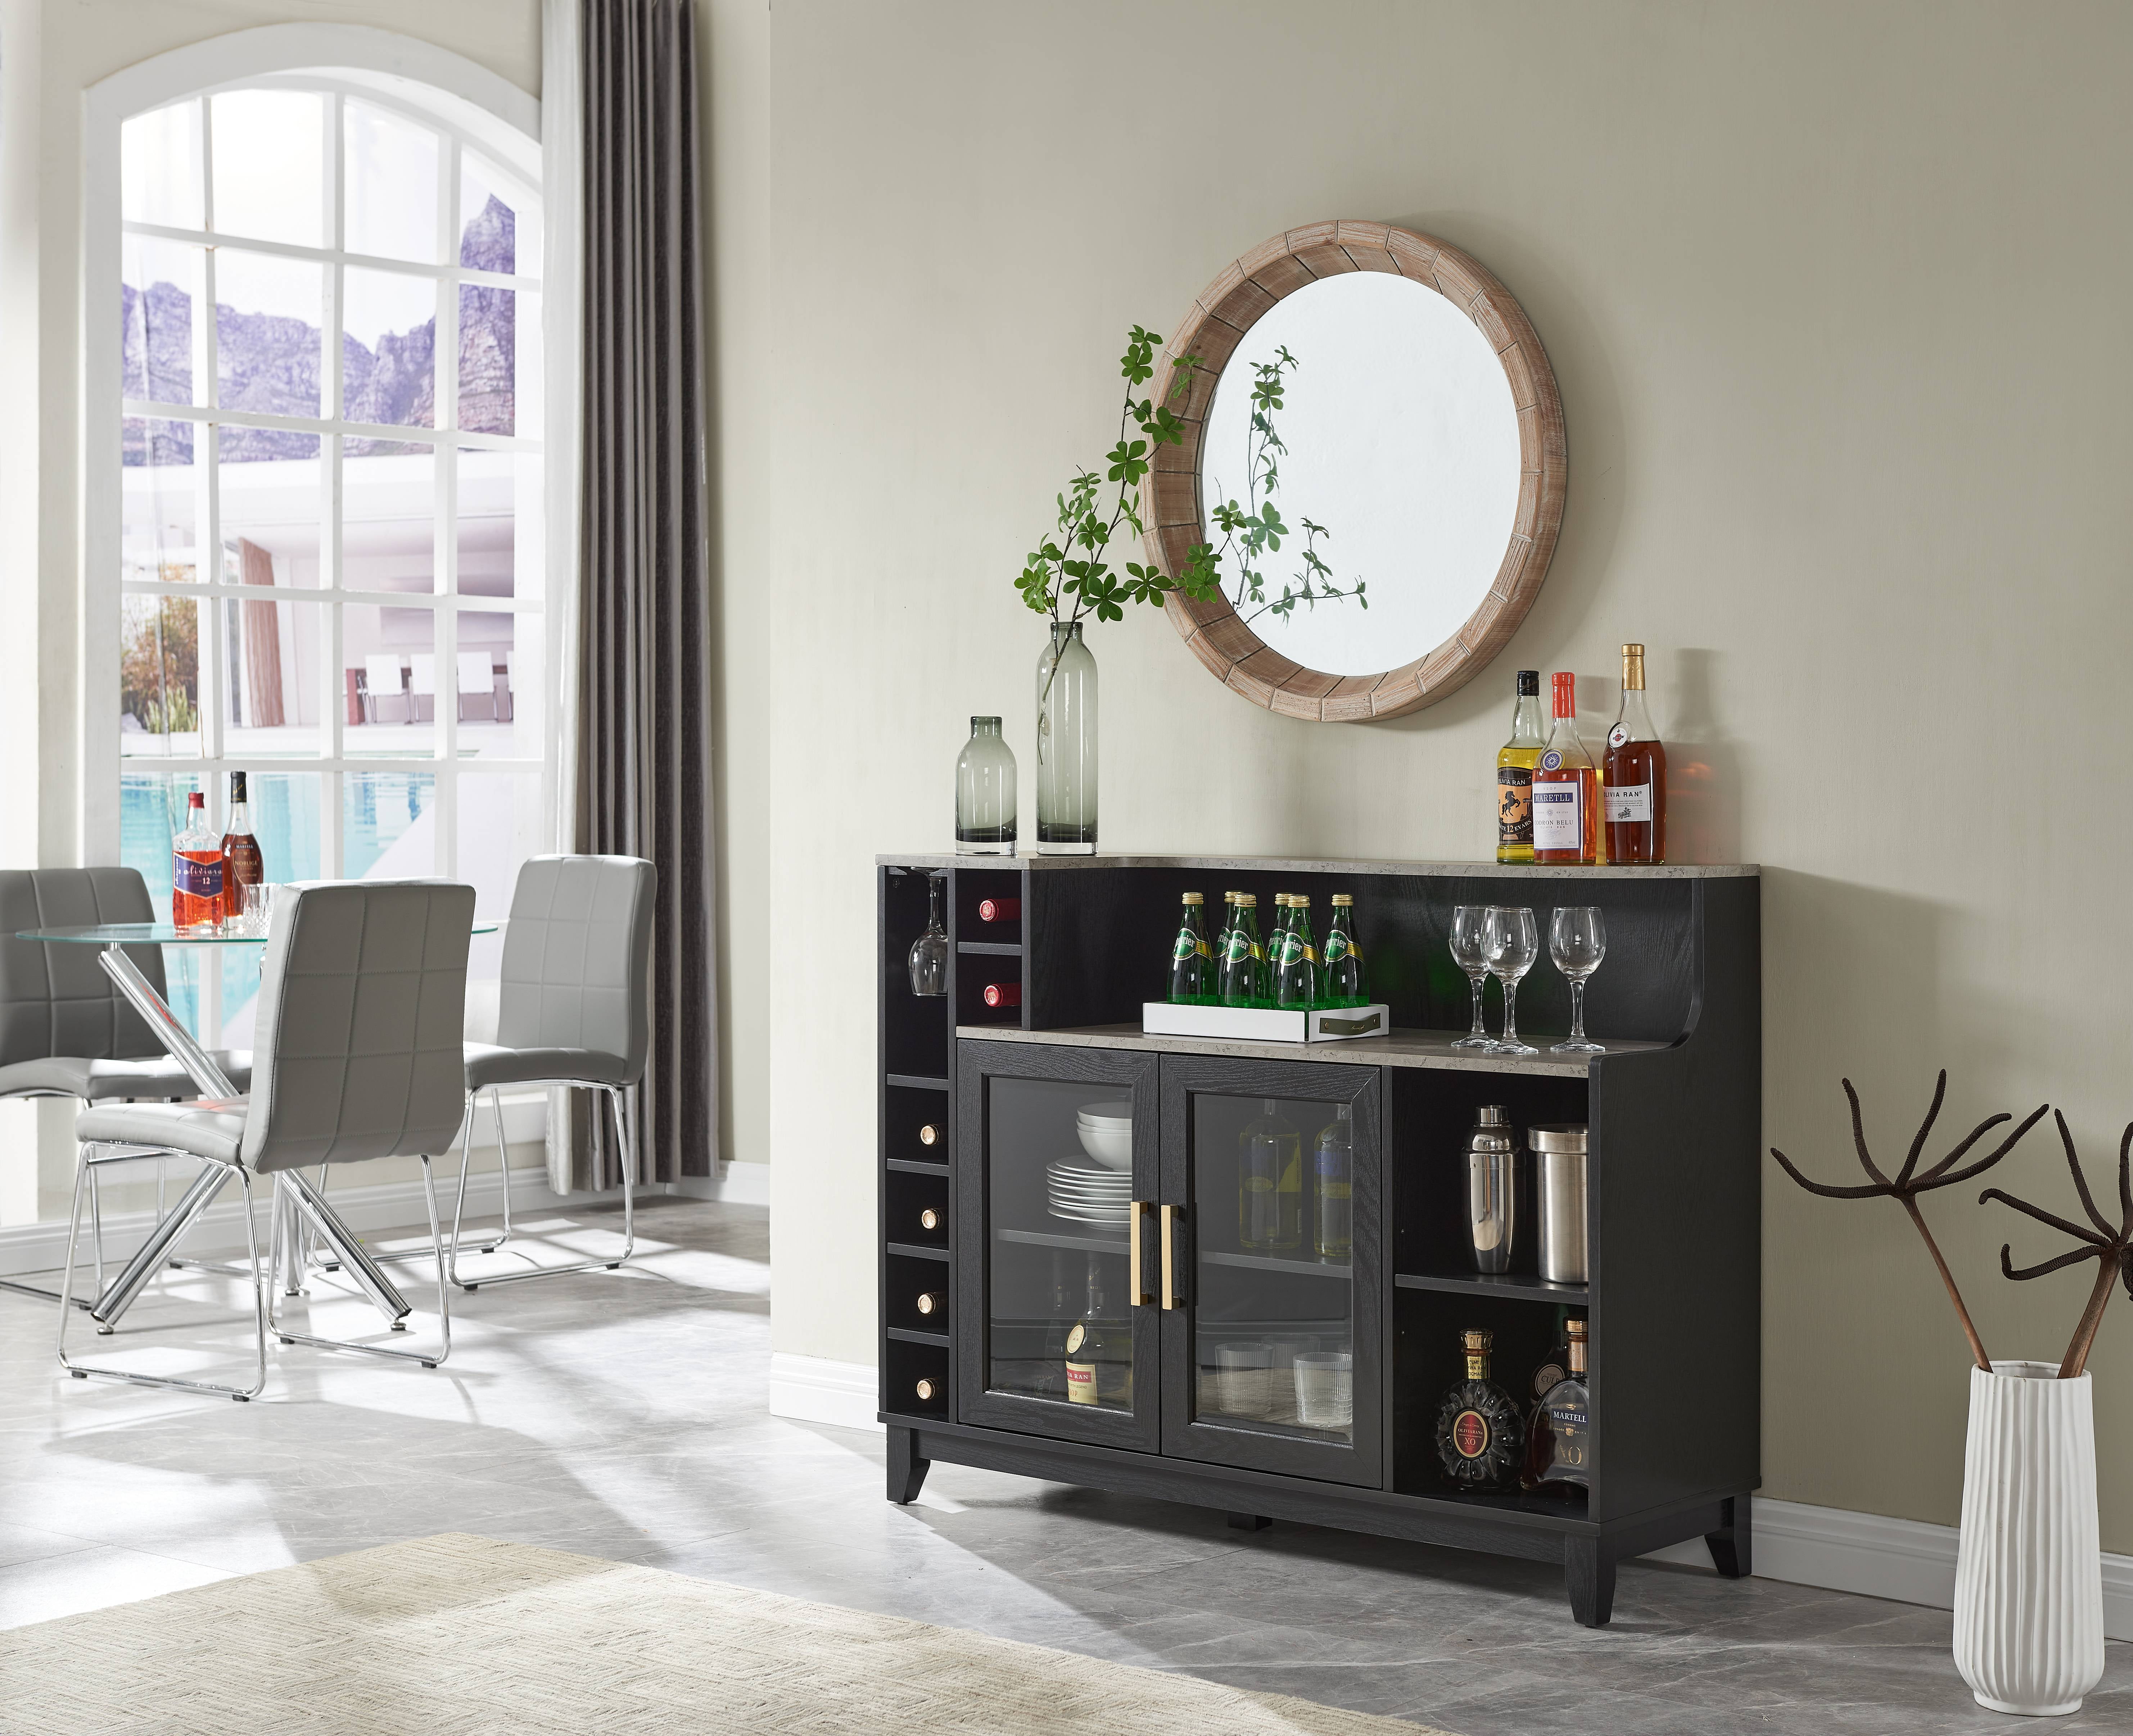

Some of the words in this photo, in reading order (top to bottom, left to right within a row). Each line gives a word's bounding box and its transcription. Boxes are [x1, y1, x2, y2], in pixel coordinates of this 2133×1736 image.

[1514, 819, 1532, 831] EYARS
[203, 876, 211, 885] 12
[1554, 1411, 1586, 1423] MARTELL
[1465, 1437, 1476, 1446] XO
